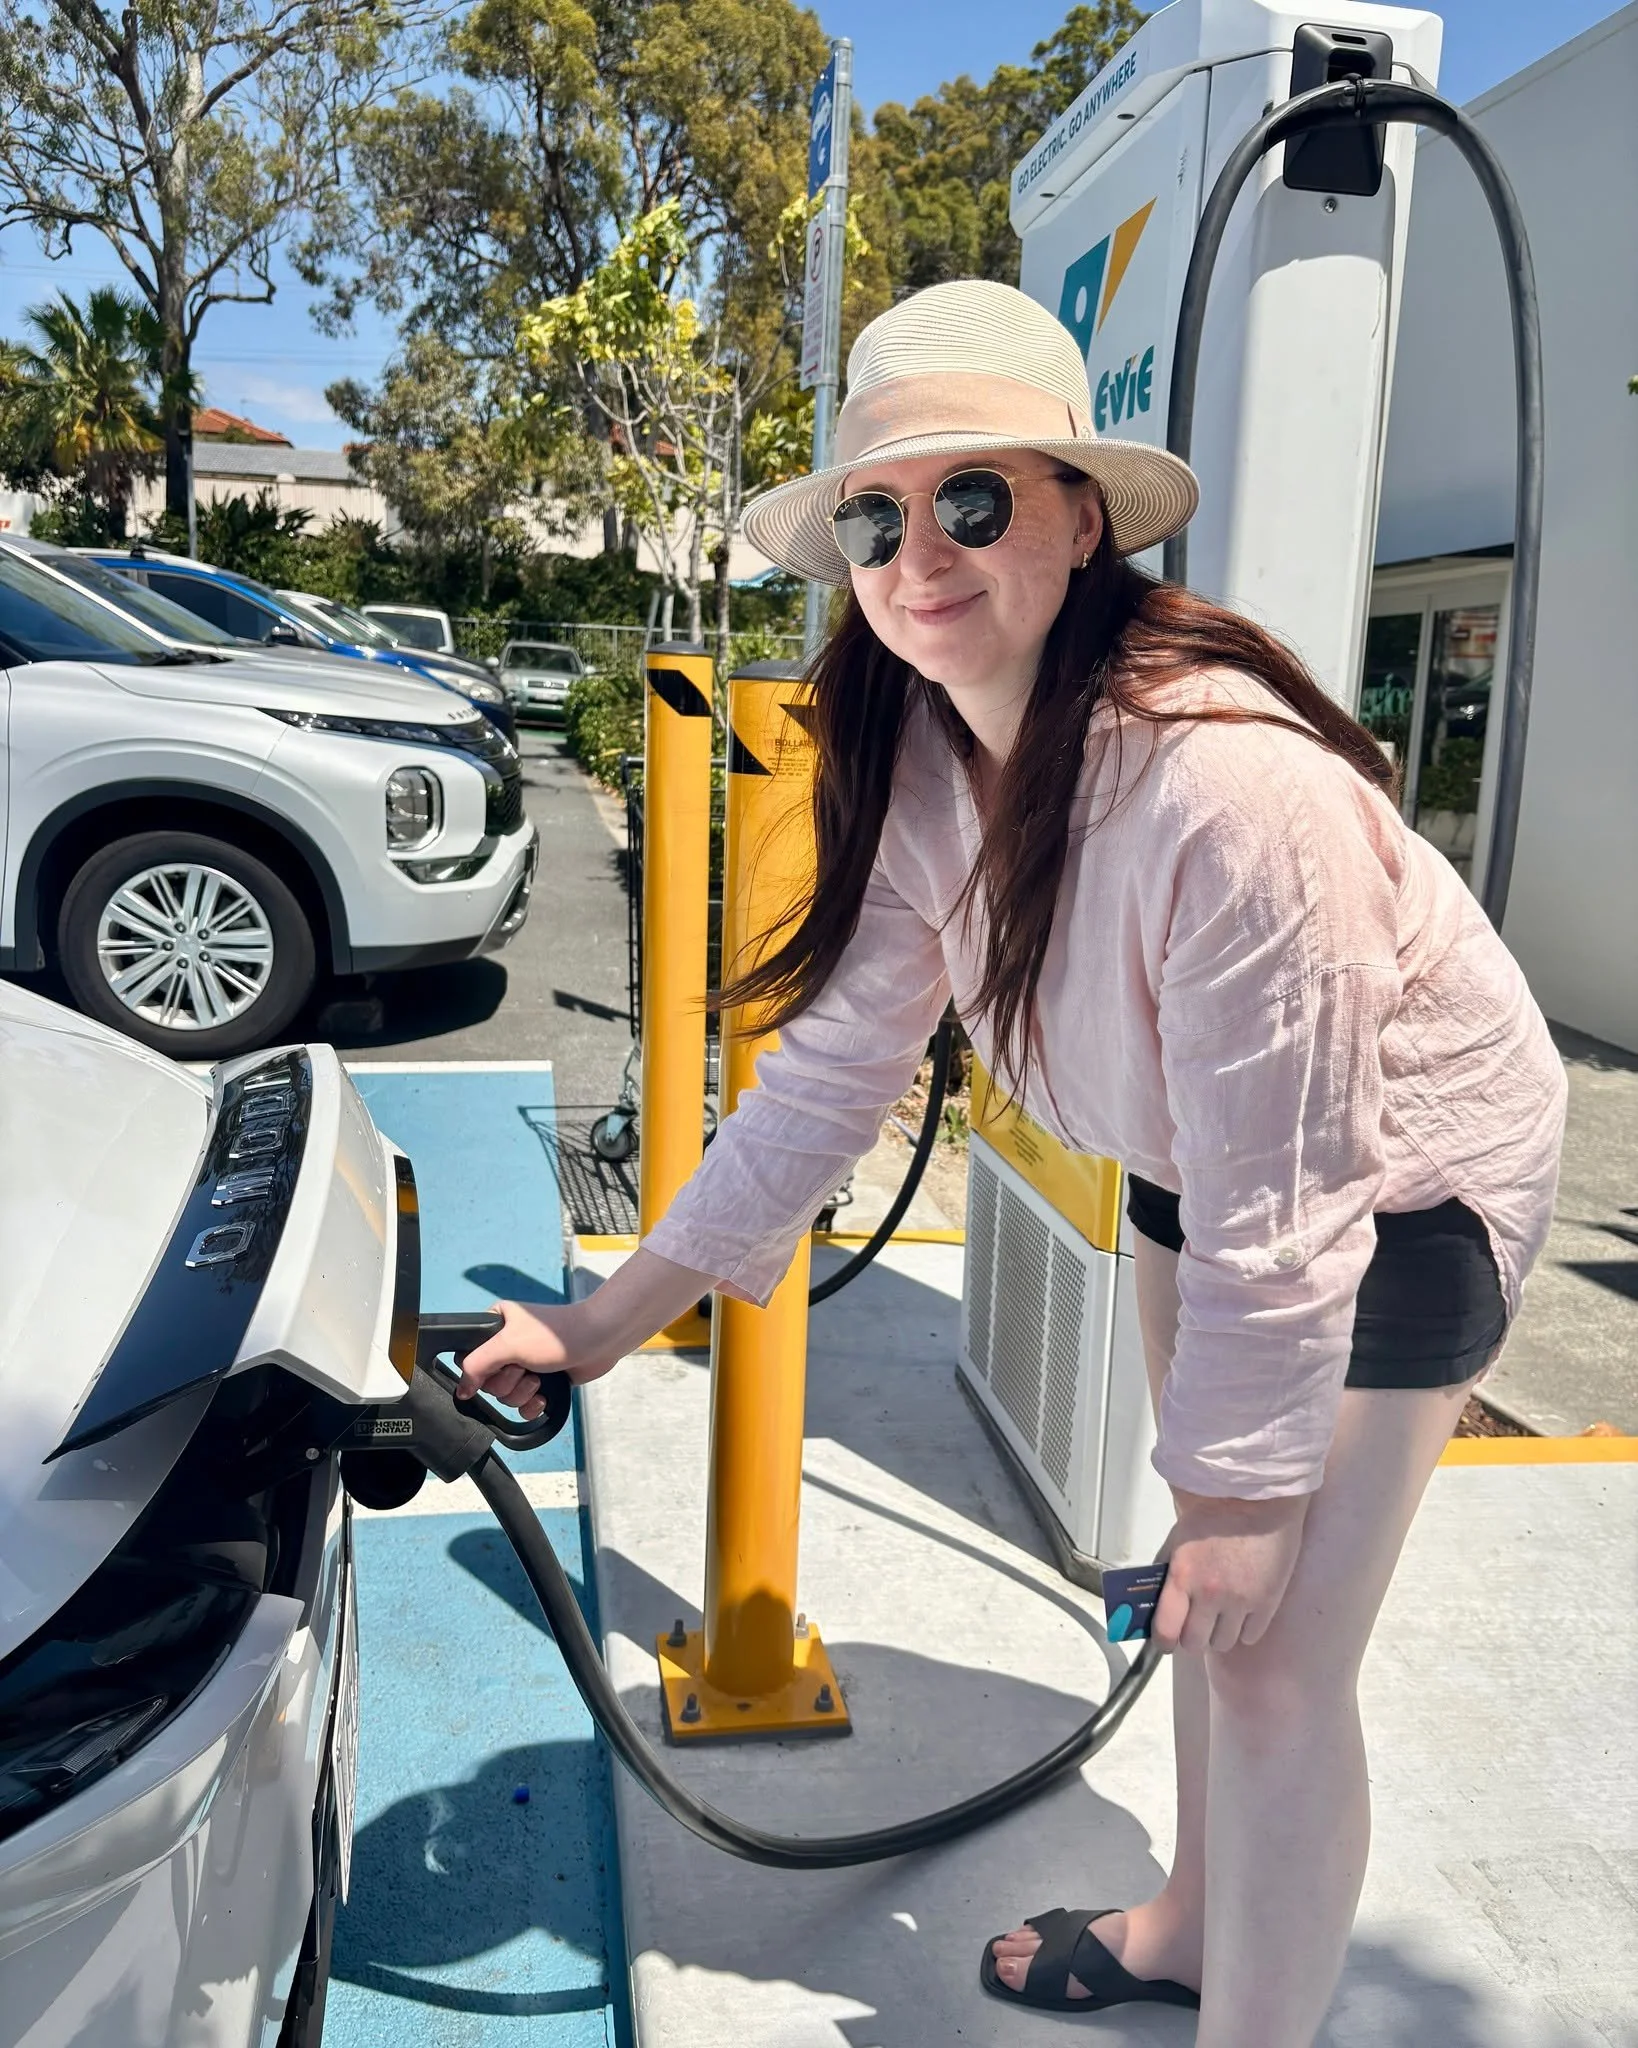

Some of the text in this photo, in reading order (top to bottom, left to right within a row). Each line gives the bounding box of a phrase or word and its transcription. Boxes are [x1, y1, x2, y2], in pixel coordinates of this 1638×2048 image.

[1017, 51, 1137, 194] GO ELECTRIC. GO ANYWHERE
